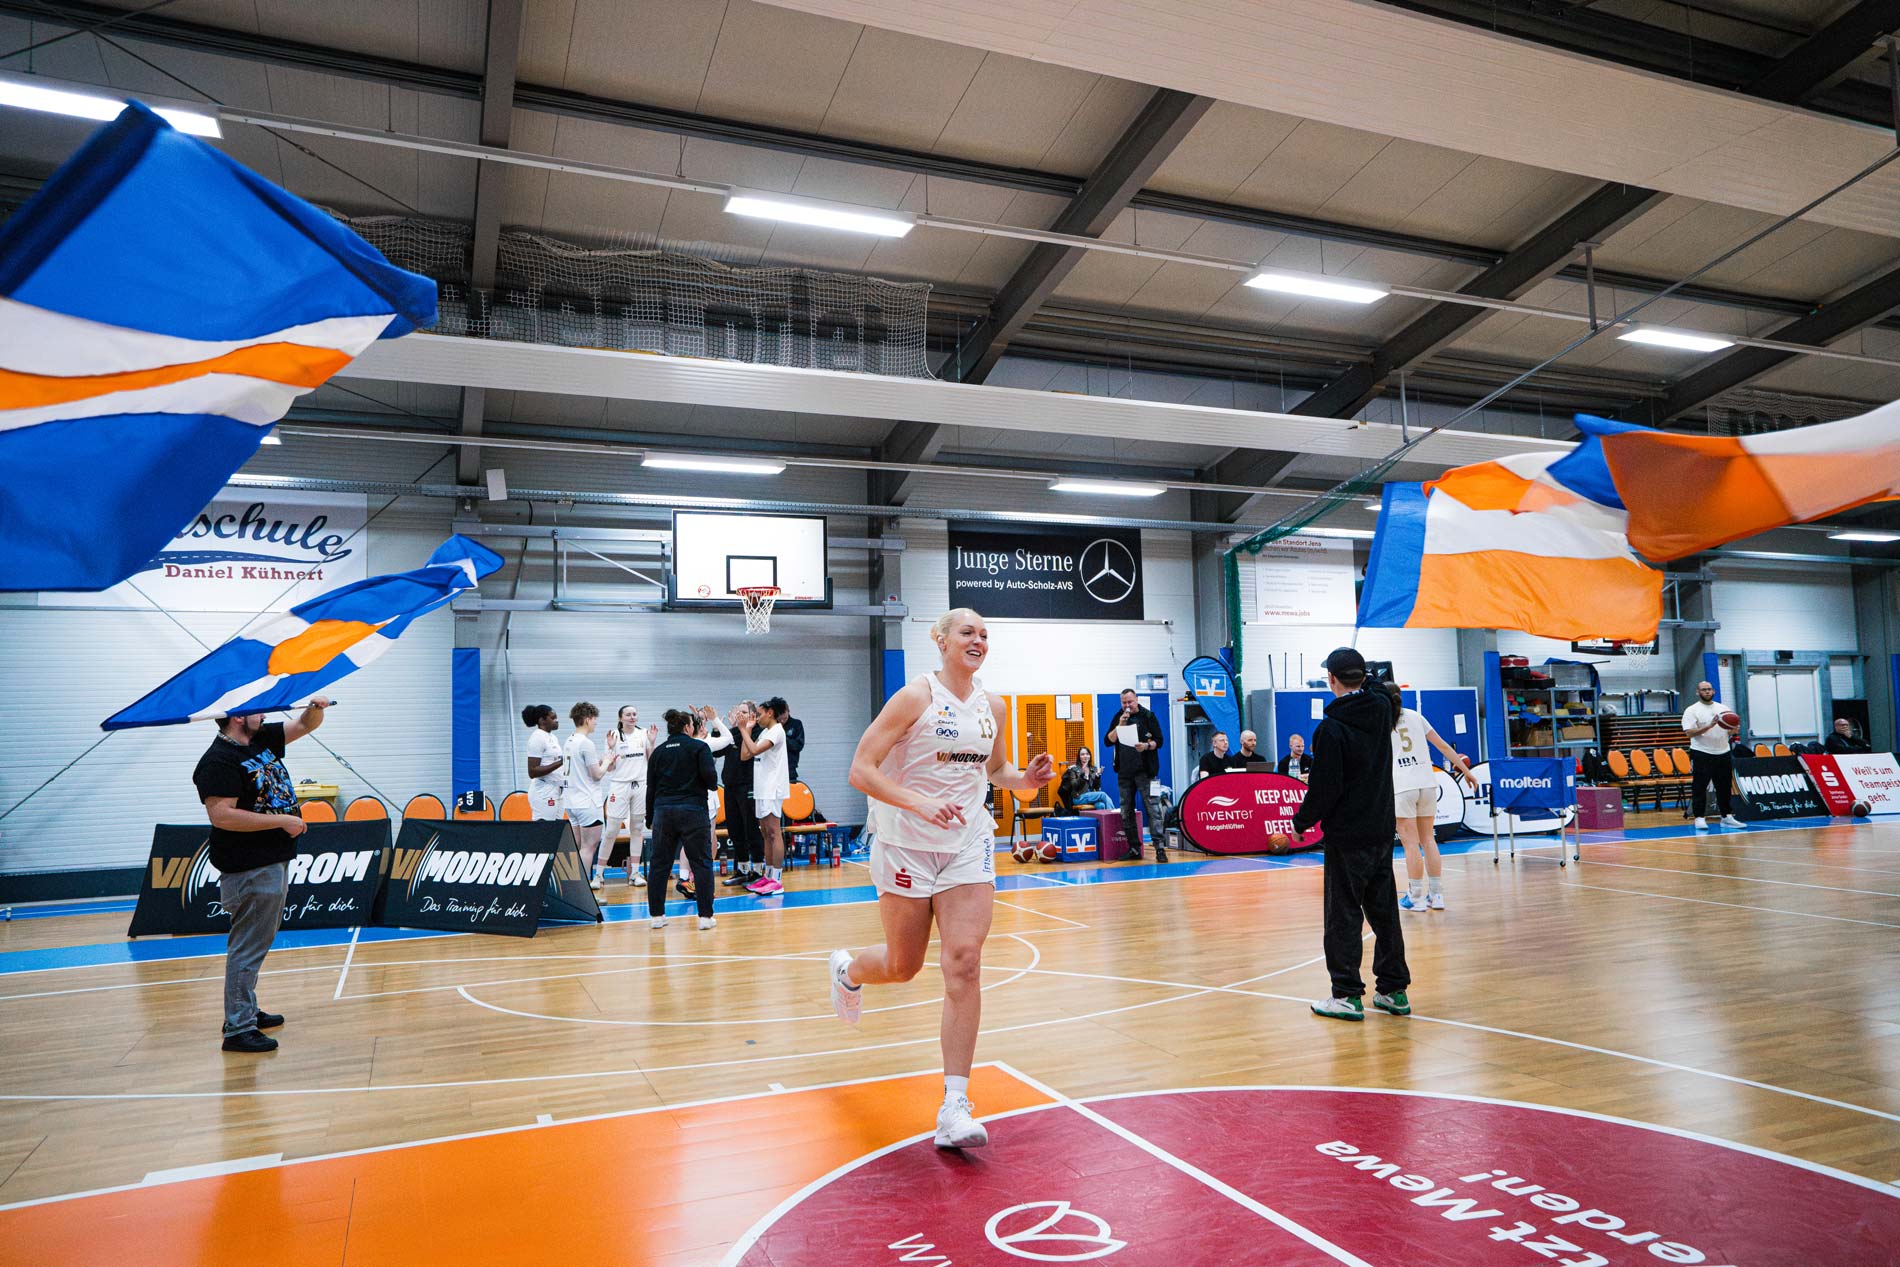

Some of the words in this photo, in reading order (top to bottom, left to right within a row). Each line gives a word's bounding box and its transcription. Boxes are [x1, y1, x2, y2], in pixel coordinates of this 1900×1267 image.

[176, 502, 352, 556] schule
[955, 546, 1009, 575] Junge
[1015, 548, 1073, 572] Sterne
[165, 564, 233, 579] Daniel
[241, 566, 323, 580] Kühnert
[956, 579, 992, 589] powered
[994, 580, 1004, 590] by
[1006, 579, 1073, 590] Auto-Scholz-AVS
[978, 718, 994, 739] 13
[1880, 767, 1893, 775] um
[1500, 776, 1552, 789] molten
[1255, 789, 1281, 804] KEEP
[1279, 806, 1294, 816] AND
[300, 894, 322, 919] für
[420, 896, 441, 913] Das
[446, 896, 484, 922] Training
[482, 896, 501, 922] für
[1314, 1140, 1504, 1222] Mewa
[1458, 1169, 1707, 1265] erden!
